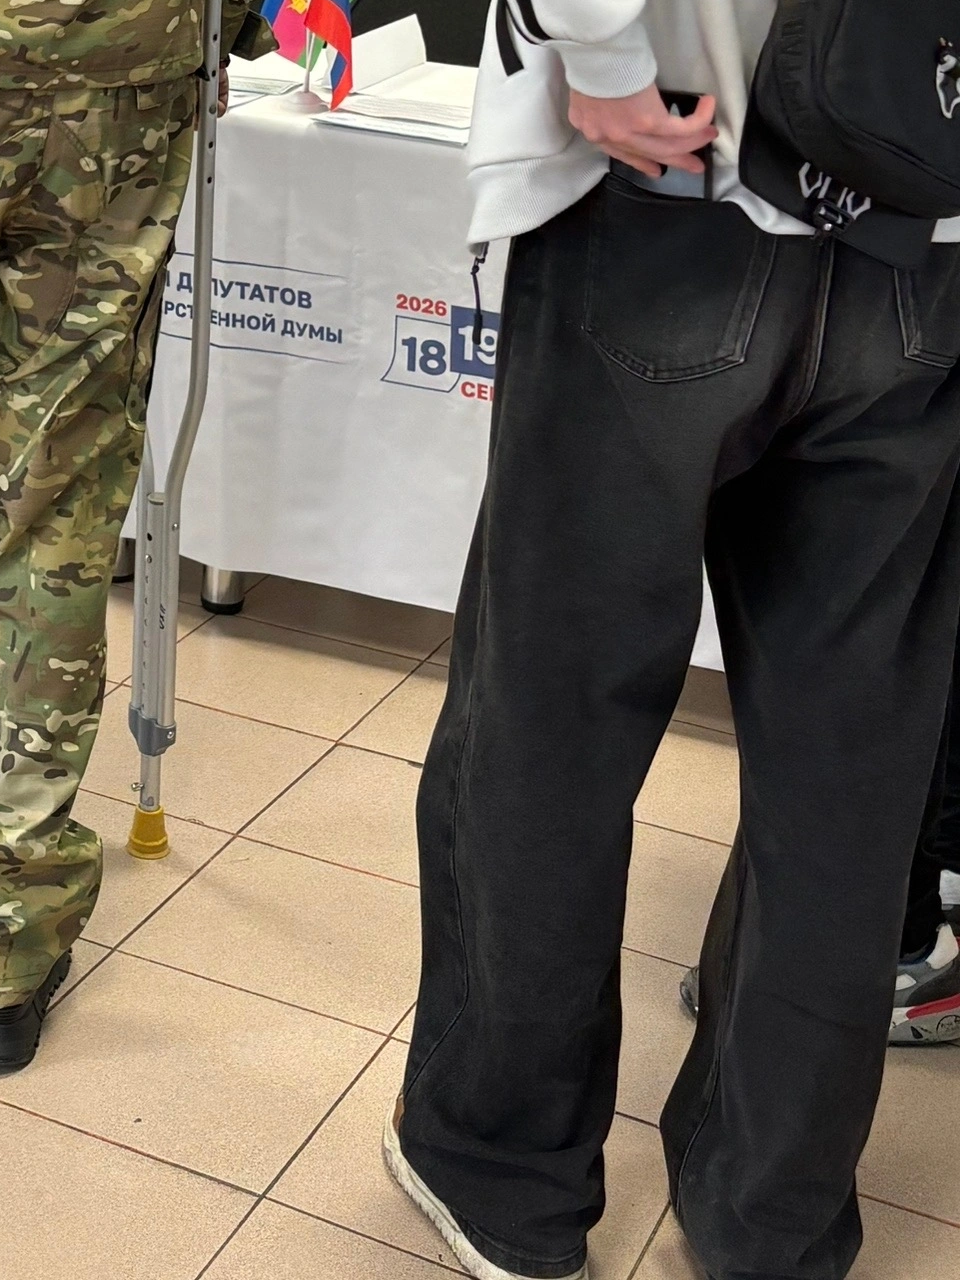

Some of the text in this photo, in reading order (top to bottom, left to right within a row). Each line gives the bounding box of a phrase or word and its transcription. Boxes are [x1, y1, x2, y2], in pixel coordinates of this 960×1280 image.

[176, 272, 312, 309] ДПУТАТОВ
[396, 294, 447, 317] 2026
[164, 301, 342, 344] РСТЕННОЙ ДУМЫ
[402, 325, 498, 376] 18 19
[460, 381, 494, 402] СЕ
